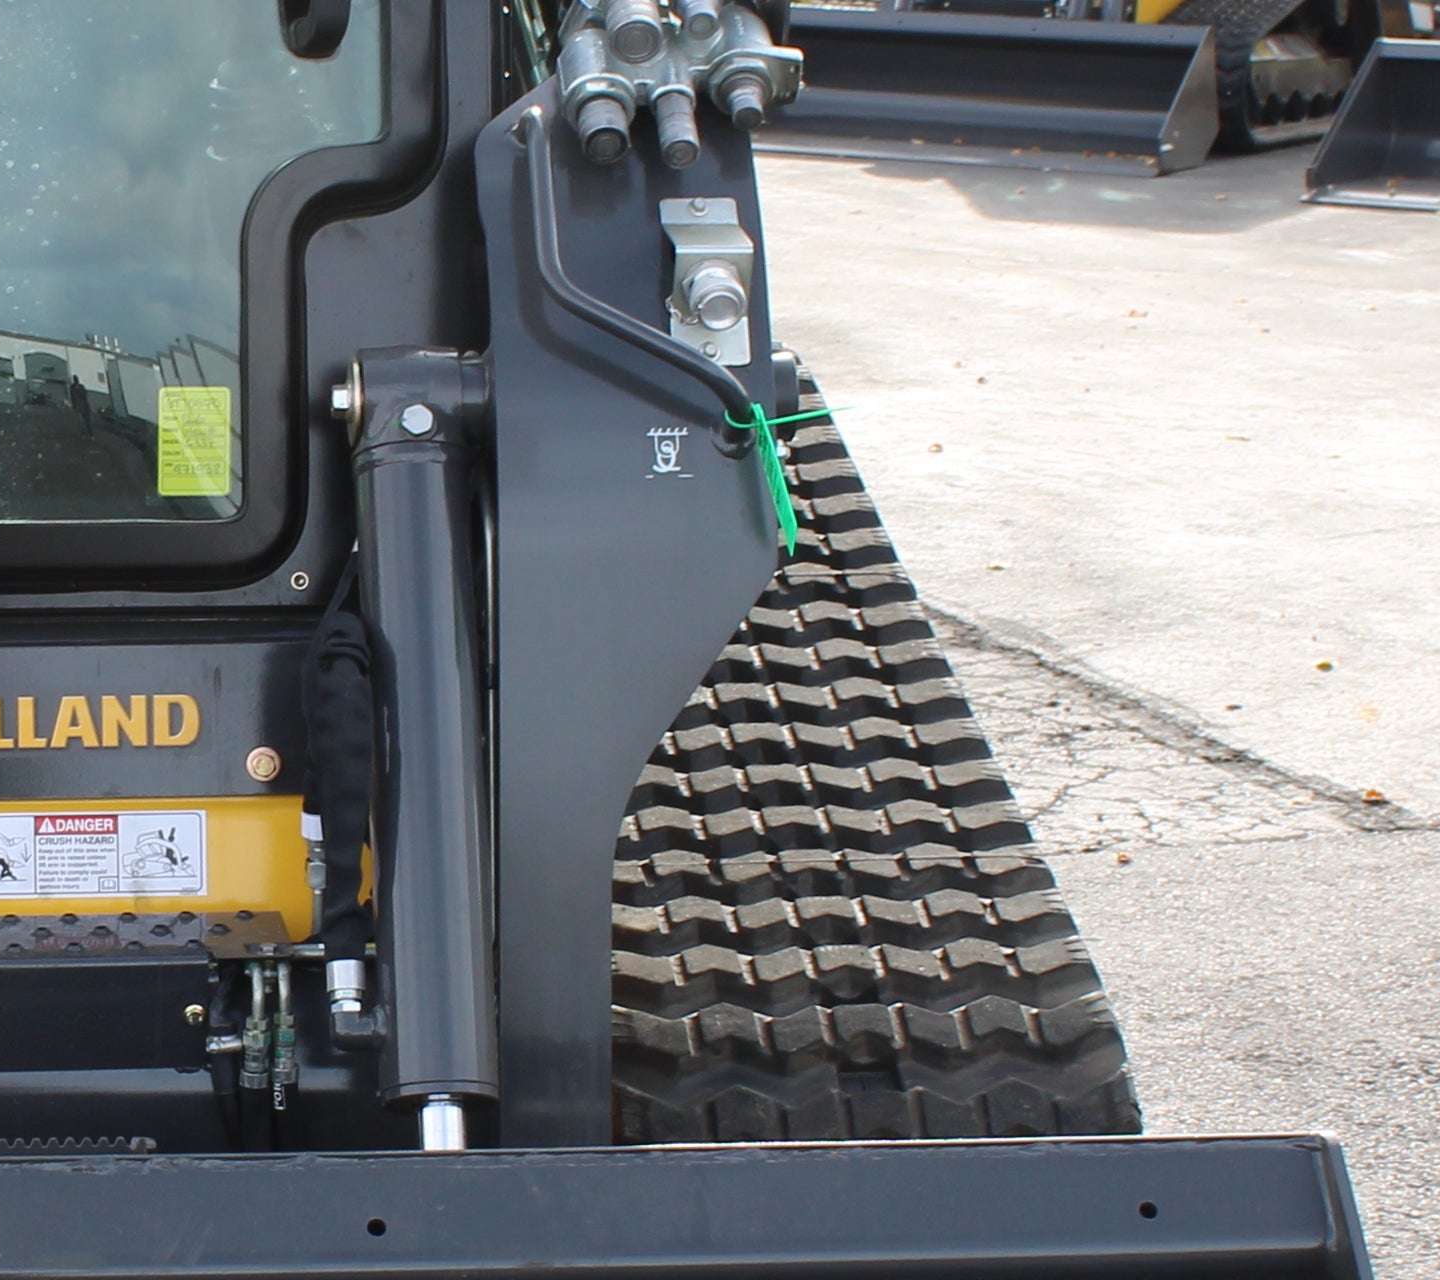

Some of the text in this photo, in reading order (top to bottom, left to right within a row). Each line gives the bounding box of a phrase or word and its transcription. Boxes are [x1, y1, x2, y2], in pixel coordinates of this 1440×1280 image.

[56, 818, 114, 831] DANGER
[38, 835, 115, 846] CRUSH HAZARD
